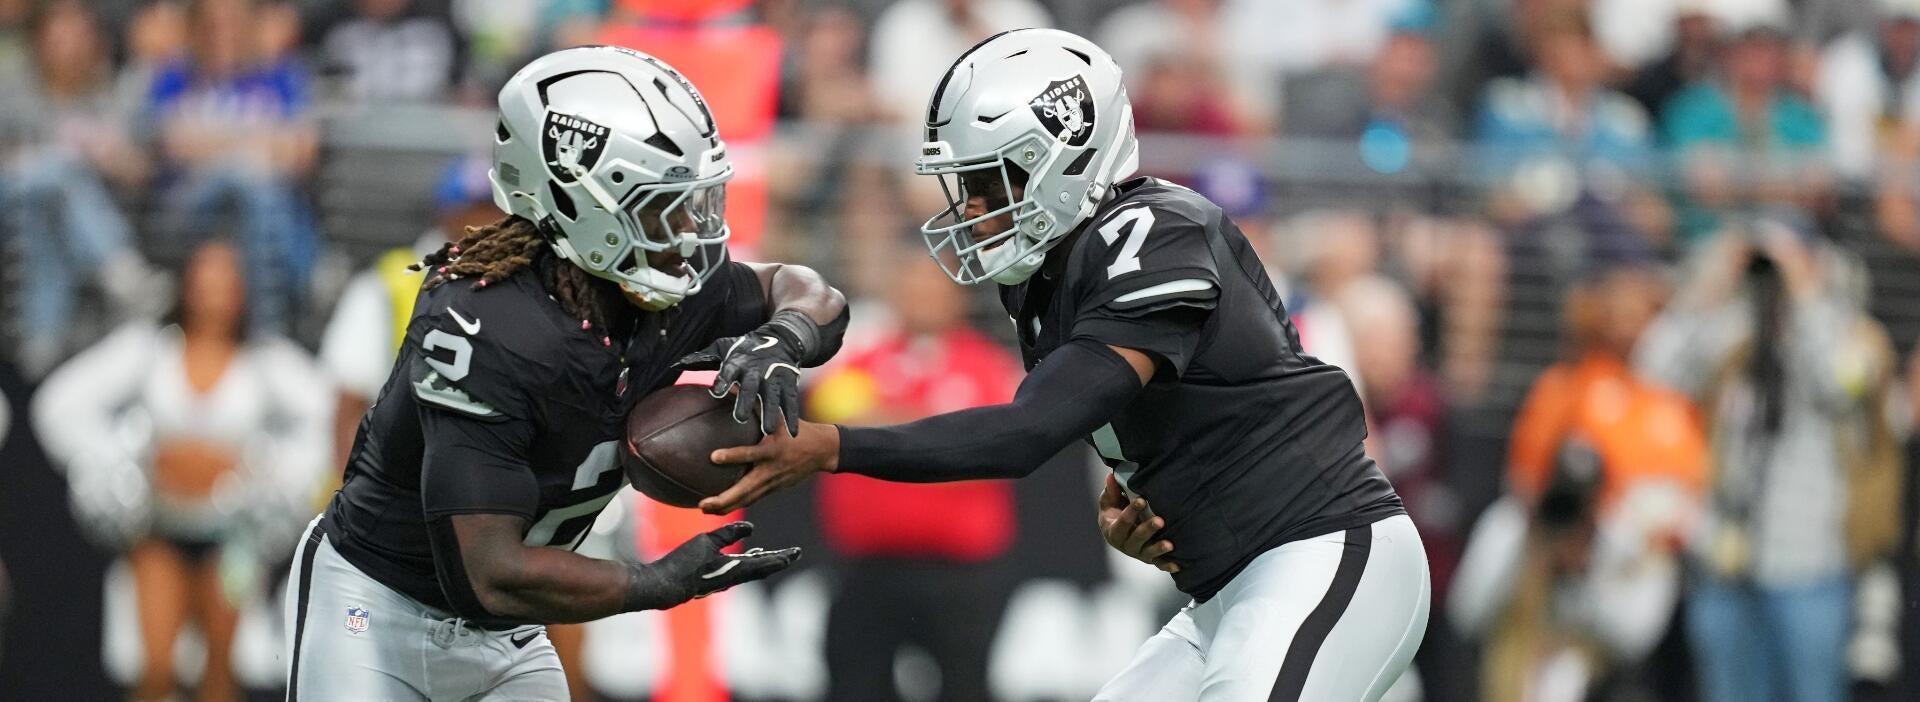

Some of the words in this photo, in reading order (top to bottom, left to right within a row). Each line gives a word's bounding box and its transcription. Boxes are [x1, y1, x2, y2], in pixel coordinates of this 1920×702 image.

[1034, 77, 1080, 107] RAIDERS
[551, 113, 604, 136] RAIDERS
[1098, 206, 1155, 280] 7
[416, 328, 480, 405] 2
